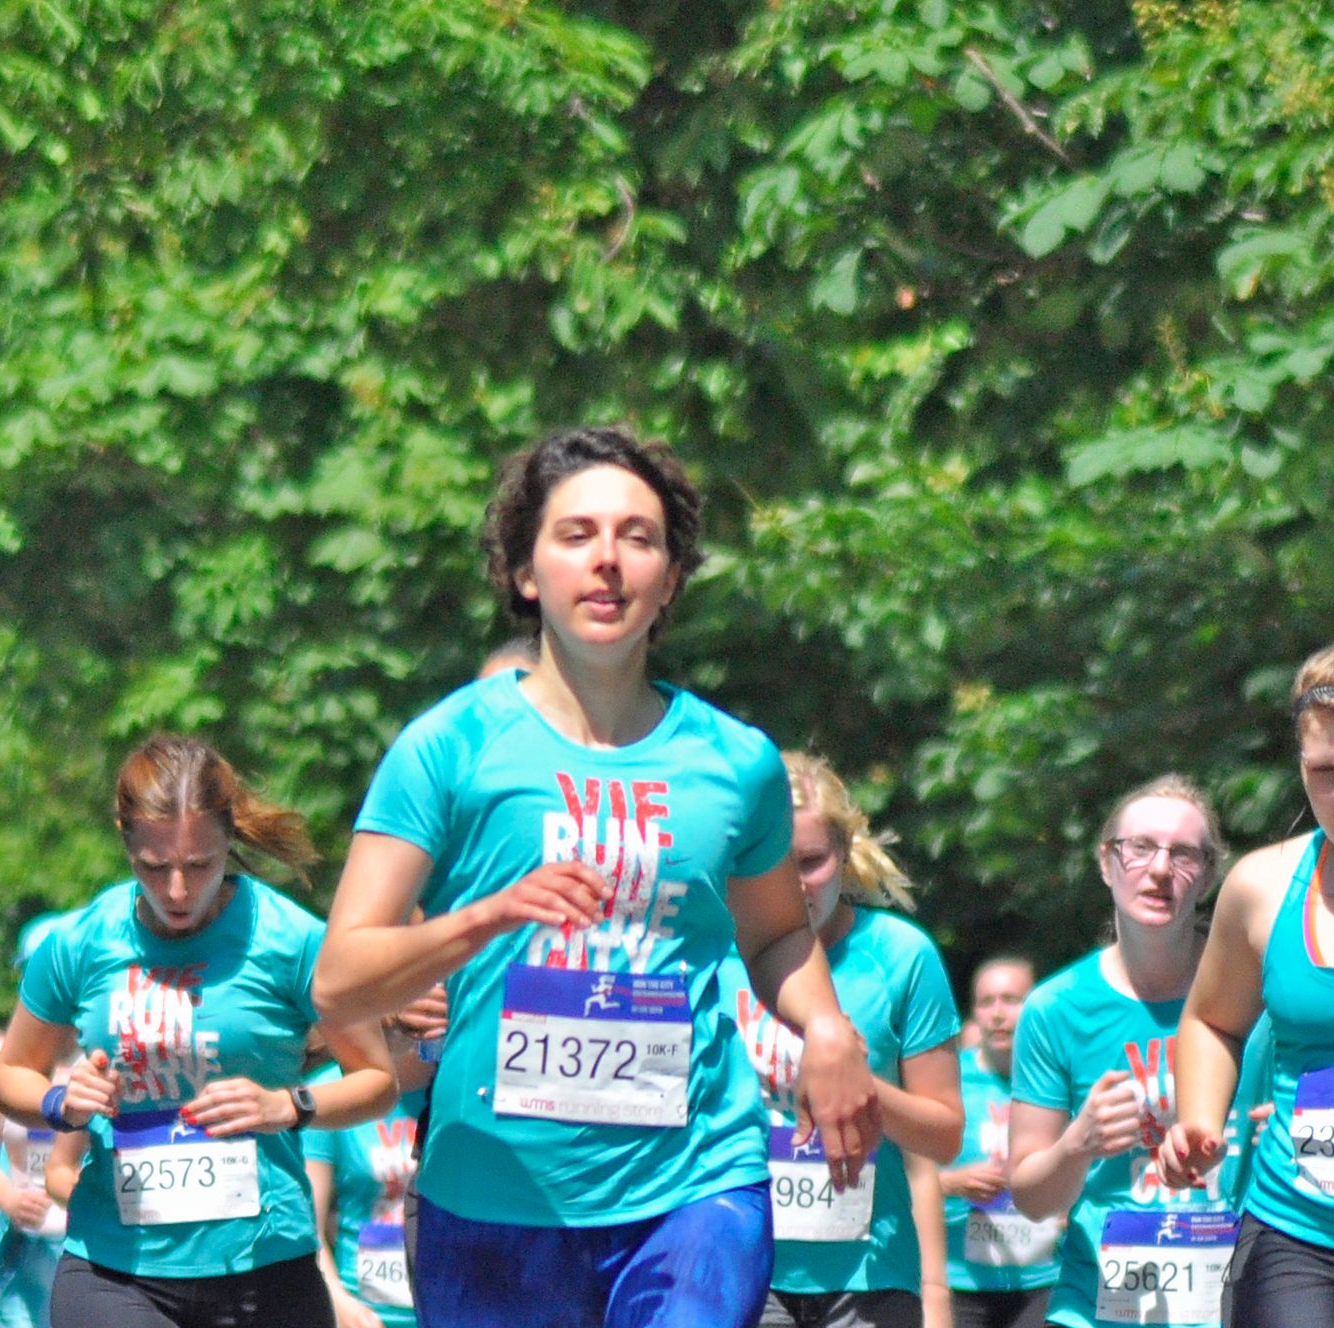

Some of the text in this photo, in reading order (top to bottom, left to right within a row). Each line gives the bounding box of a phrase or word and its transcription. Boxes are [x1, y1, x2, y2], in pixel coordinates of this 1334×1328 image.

[542, 811, 660, 893] RUN
[503, 1030, 679, 1081] 21372 10K-F
[120, 1155, 216, 1194] 22573
[771, 1176, 836, 1209] 984
[1103, 1258, 1194, 1293] 25621
